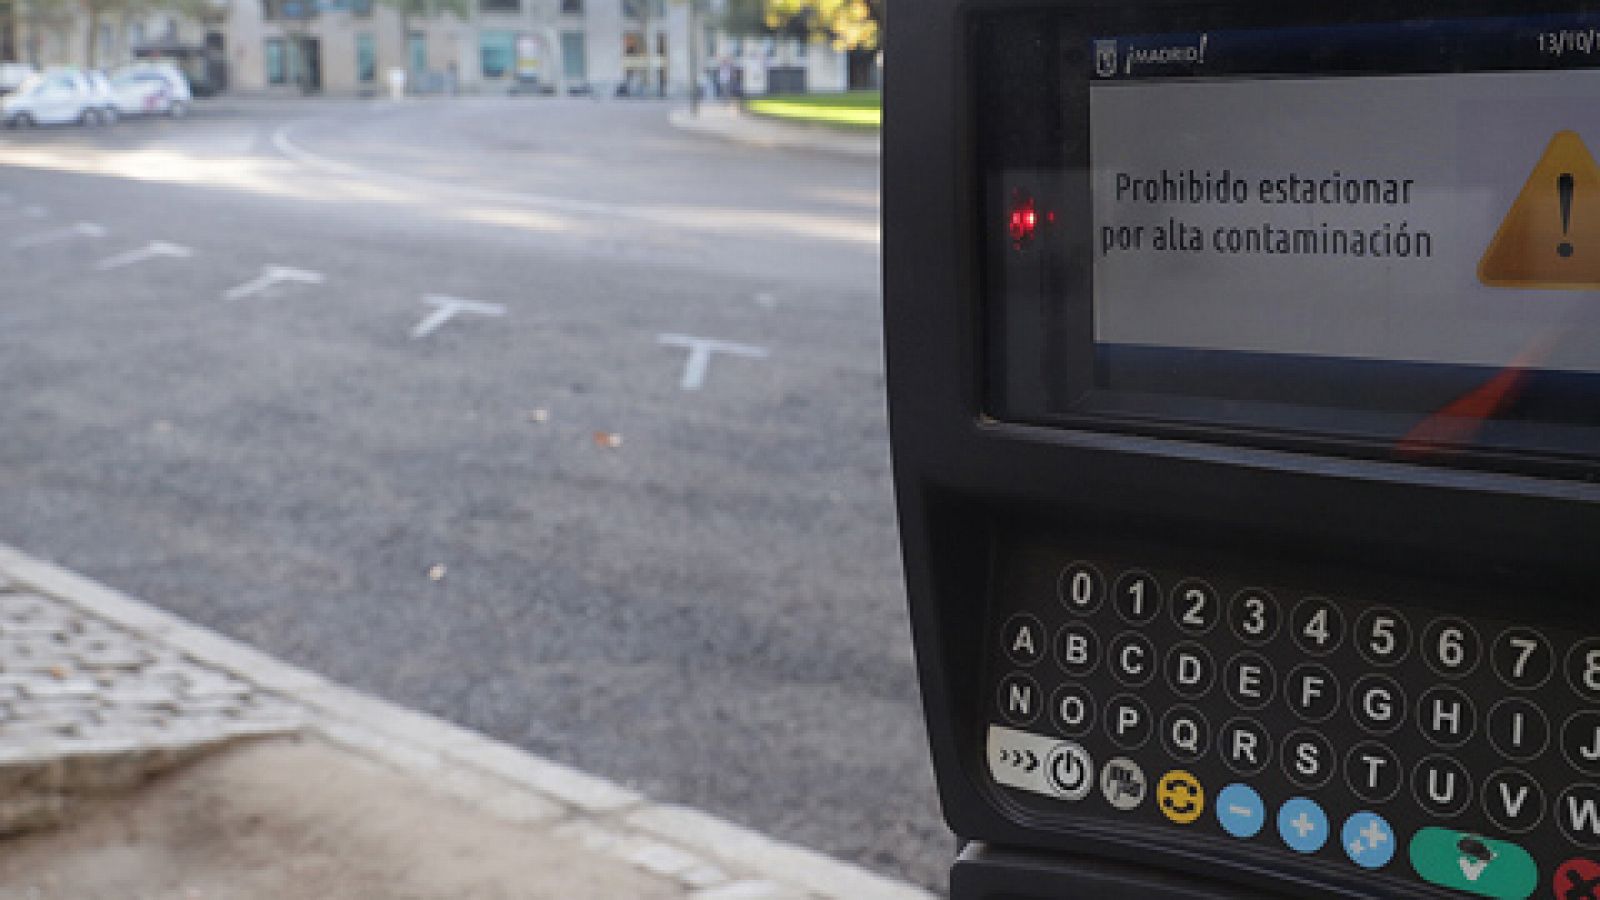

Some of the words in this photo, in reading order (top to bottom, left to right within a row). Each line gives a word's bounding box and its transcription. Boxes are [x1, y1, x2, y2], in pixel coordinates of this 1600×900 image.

[1102, 225, 1145, 256] por
[1152, 217, 1204, 250] alta
[1212, 221, 1432, 257] contaminación
[1116, 170, 1248, 203] Prohibido
[1259, 170, 1414, 203] estacionar
[1072, 572, 1091, 604] 0
[1129, 580, 1144, 614] 1
[1183, 589, 1205, 624] 2
[1243, 599, 1265, 634] 3
[1303, 609, 1329, 644] 4
[1369, 616, 1394, 654] 5
[1439, 629, 1464, 667] 6
[1509, 639, 1537, 678] 7
[1013, 626, 1034, 654] A
[1066, 633, 1087, 664] B
[1120, 646, 1144, 674] C
[1179, 653, 1201, 684] D
[1239, 665, 1261, 697] E
[1302, 676, 1324, 707] F
[1362, 689, 1391, 720] G
[1432, 700, 1461, 734] H
[1513, 713, 1524, 747] I
[1009, 683, 1031, 714] N
[1060, 696, 1085, 724] O
[1116, 706, 1138, 734] P
[1172, 719, 1198, 753] Q
[1232, 729, 1258, 764] R
[1296, 742, 1319, 774] S
[1362, 756, 1387, 788] T
[1429, 769, 1455, 803] U
[1499, 783, 1527, 818] V
